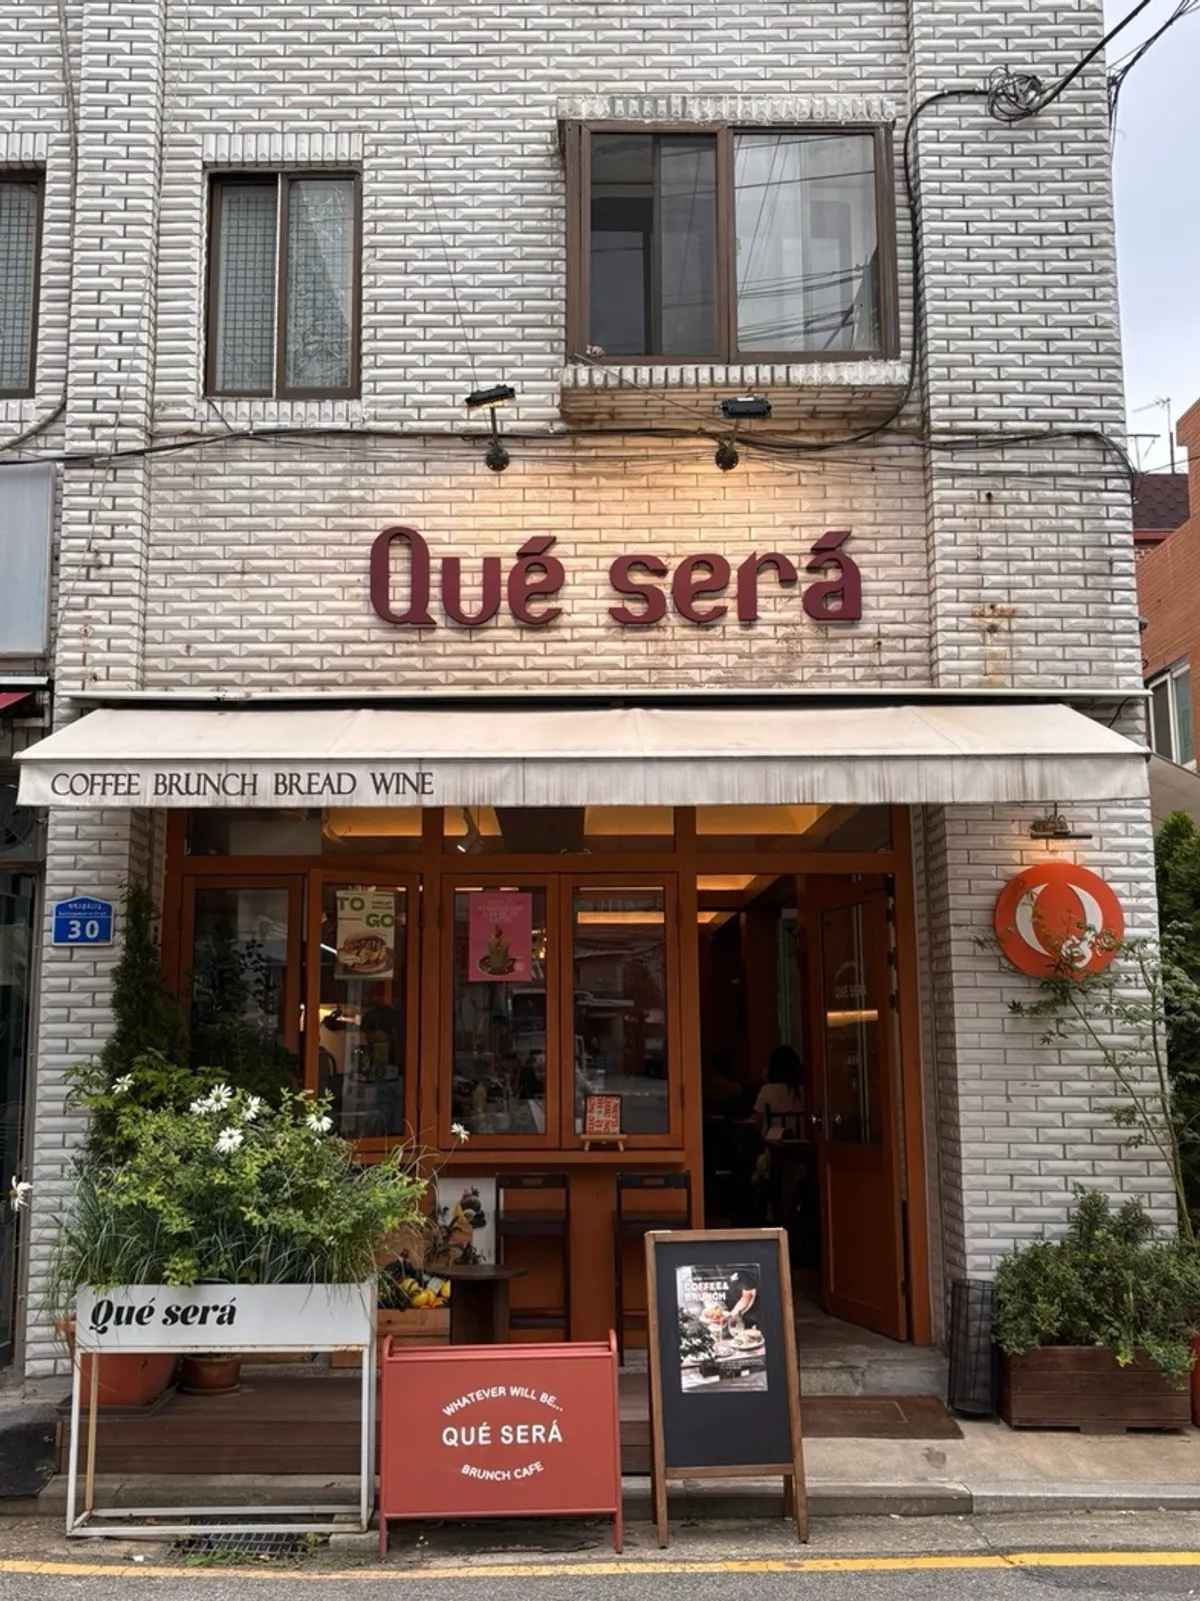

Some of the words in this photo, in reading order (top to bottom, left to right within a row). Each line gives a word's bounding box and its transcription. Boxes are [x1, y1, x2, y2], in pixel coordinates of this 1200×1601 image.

[370, 526, 566, 626] Qué
[608, 530, 862, 625] será
[50, 772, 140, 796] COFFEE
[153, 773, 258, 796] BRUNCH
[273, 772, 357, 796] BREAD
[370, 771, 434, 796] WINE
[337, 896, 366, 912] TO
[67, 919, 100, 939] 30
[365, 913, 396, 929] GO
[89, 1297, 156, 1335] Qué
[161, 1297, 237, 1326] será
[442, 1386, 507, 1416] WHATEVER
[510, 1386, 537, 1400] WILL
[539, 1392, 564, 1412] BE...
[442, 1421, 492, 1447] QUÉ
[500, 1419, 563, 1444] SERÁ
[461, 1464, 511, 1481] BRUNCH
[513, 1461, 544, 1479] CAFE
